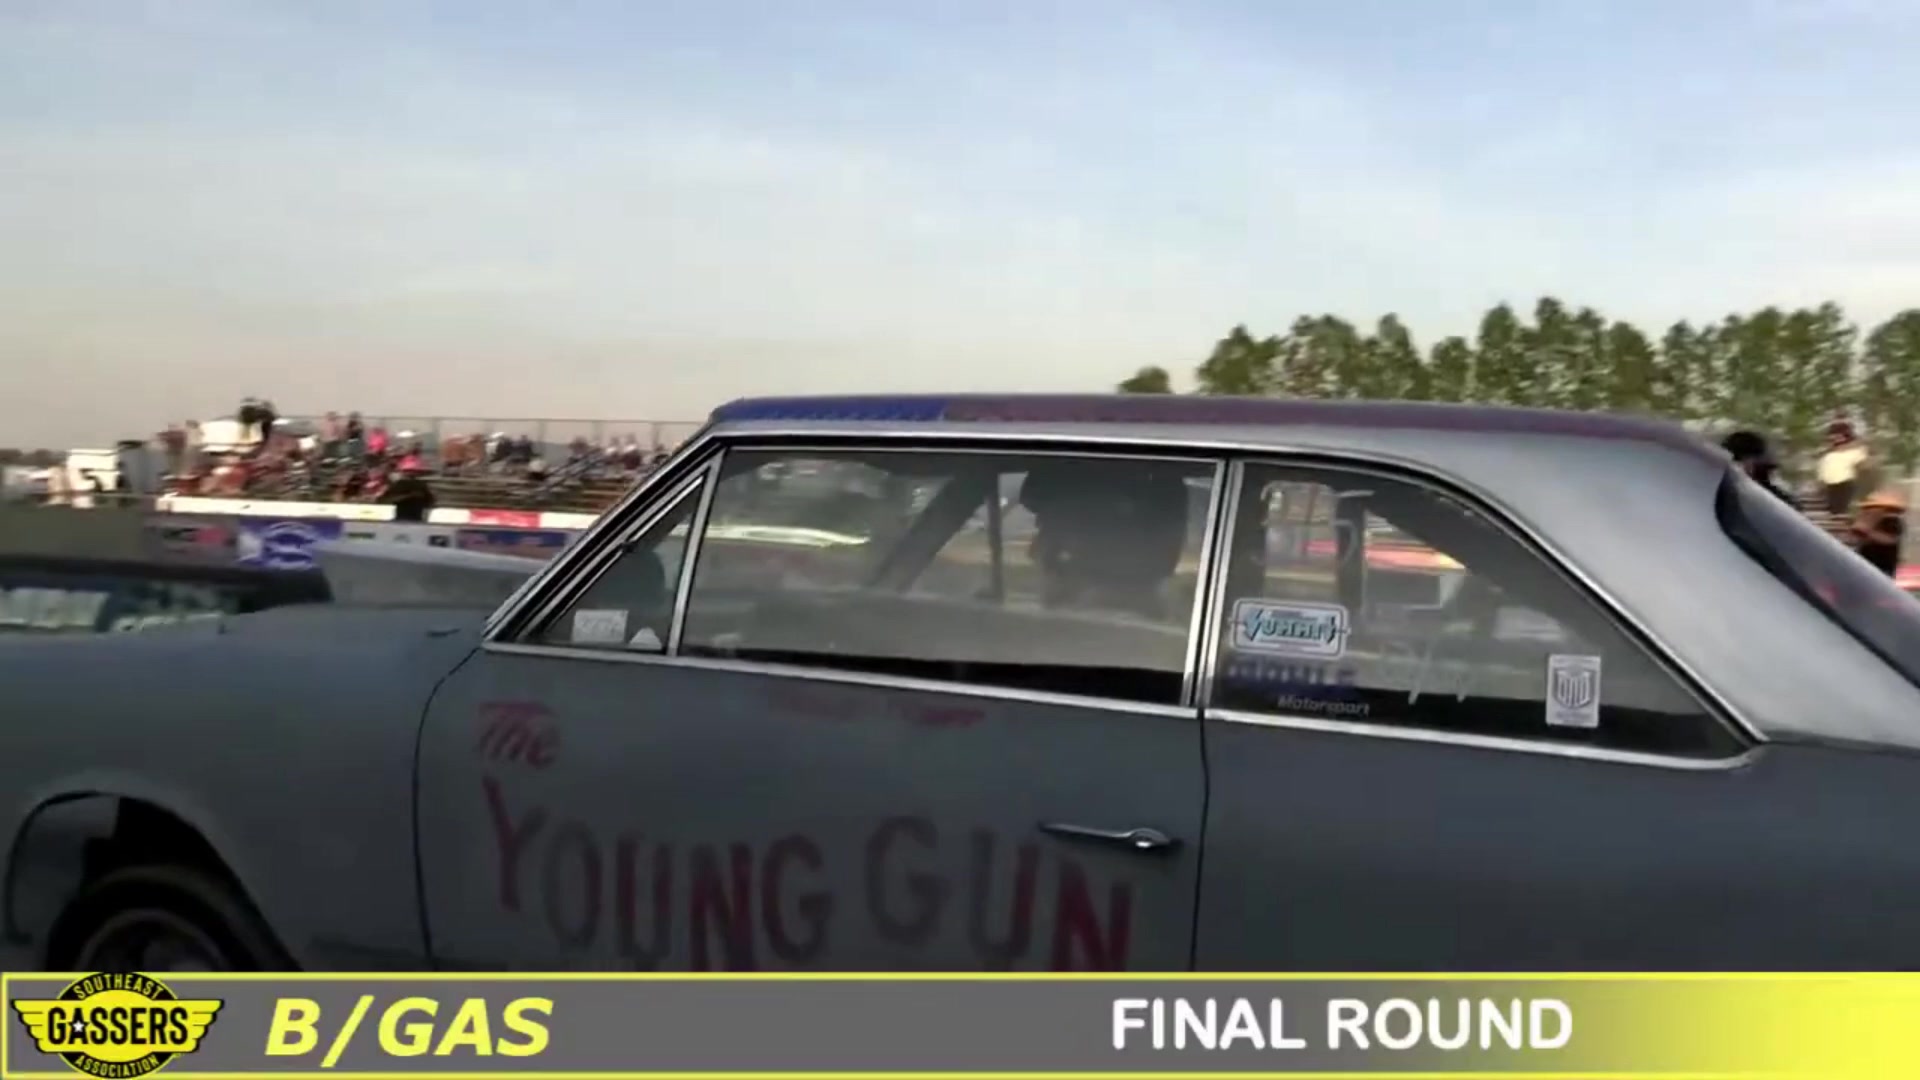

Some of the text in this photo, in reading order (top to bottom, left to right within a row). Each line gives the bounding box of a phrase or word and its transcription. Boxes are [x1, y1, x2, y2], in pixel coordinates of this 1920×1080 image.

[1278, 695, 1370, 717] Motorsport
[482, 775, 1132, 972] YOUNG GUN
